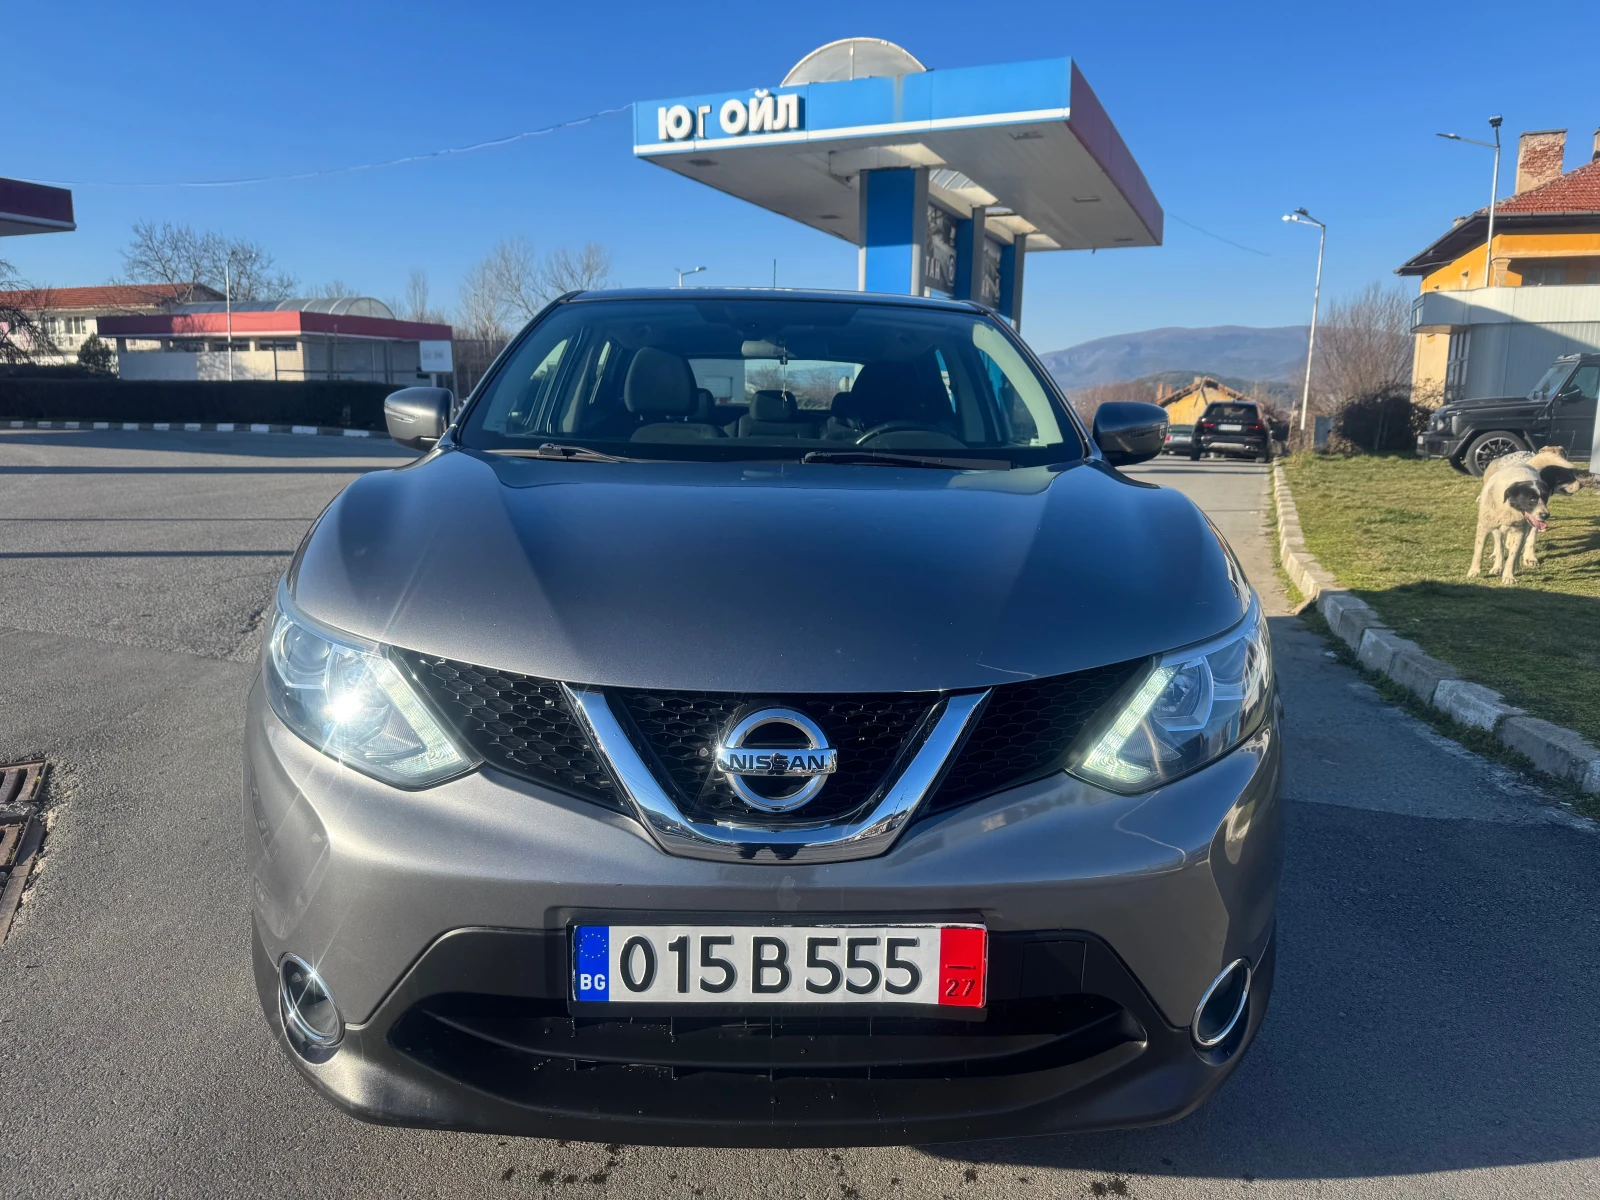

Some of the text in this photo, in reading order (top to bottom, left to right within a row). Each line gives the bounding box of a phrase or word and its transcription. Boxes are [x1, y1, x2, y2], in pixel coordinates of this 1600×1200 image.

[657, 88, 800, 141] ЮГ ОЙЛ
[729, 753, 825, 771] NISSAN
[580, 973, 606, 990] BG
[945, 978, 976, 997] 27
